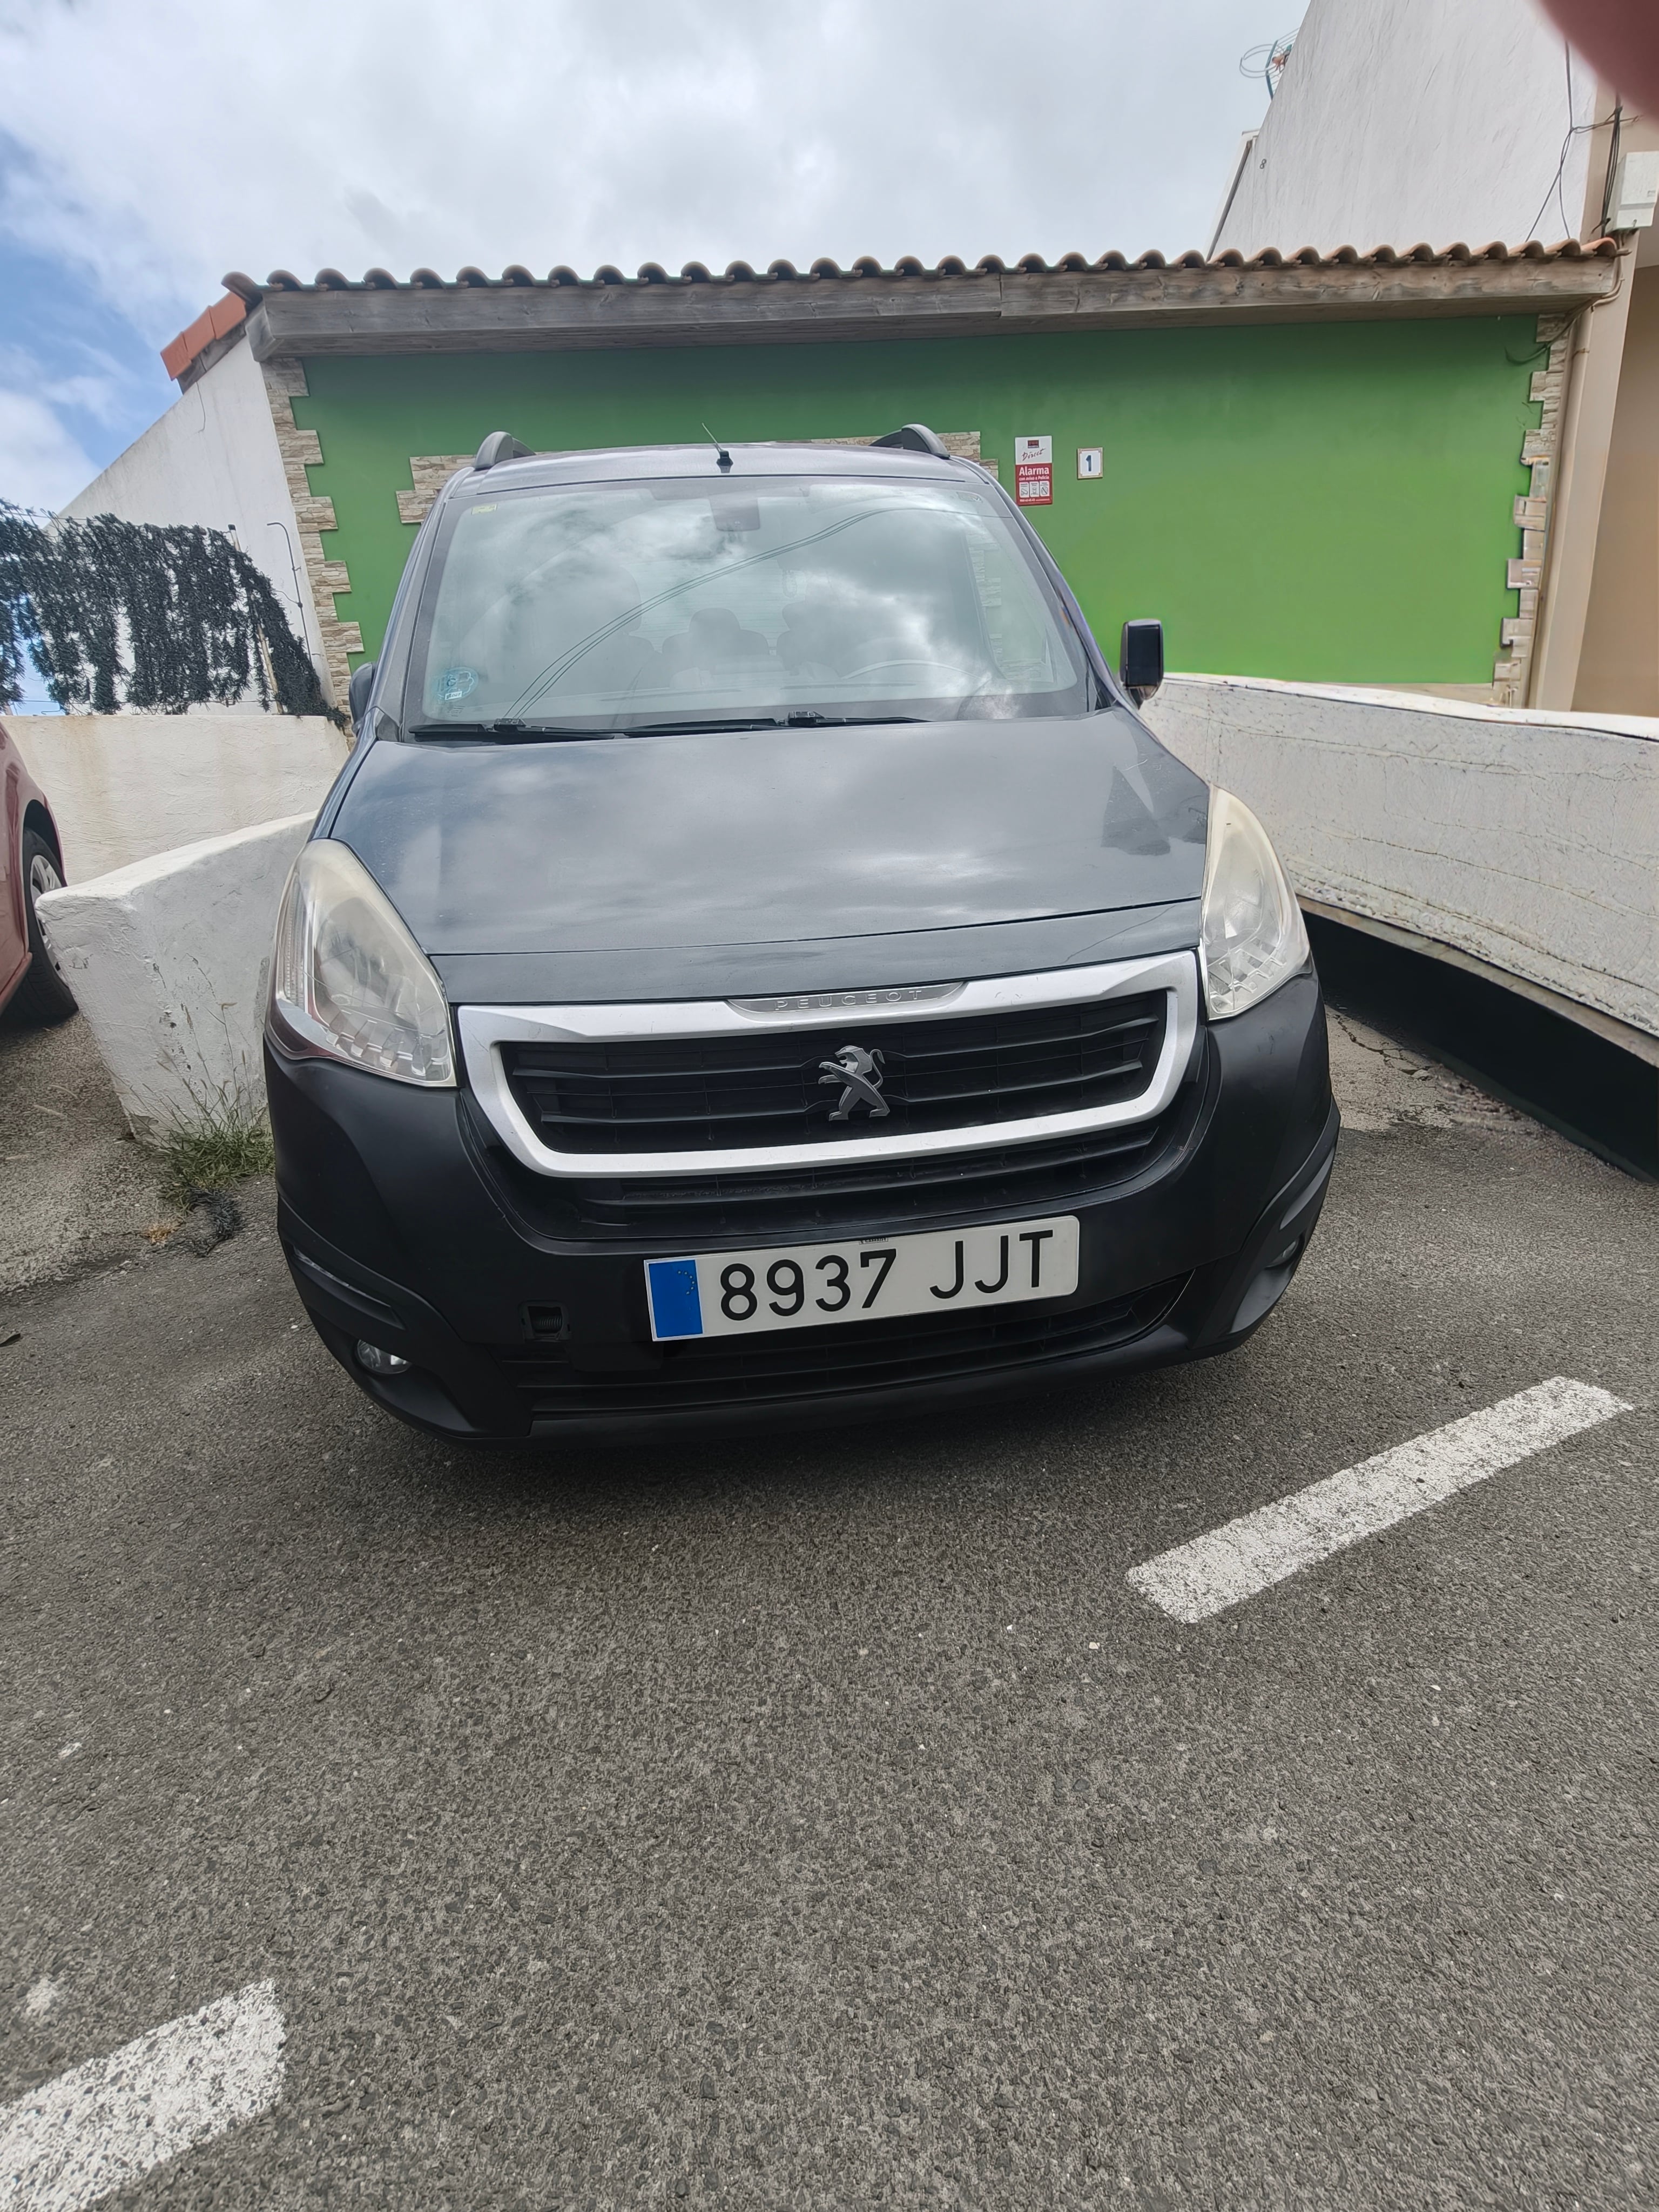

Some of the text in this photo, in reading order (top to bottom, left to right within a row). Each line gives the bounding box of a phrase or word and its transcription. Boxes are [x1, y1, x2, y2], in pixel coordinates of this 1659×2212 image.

[1019, 466, 1049, 476] Alarma
[1085, 455, 1091, 471] 1
[774, 990, 922, 1011] PEUGEOT
[720, 1230, 1054, 1321] 8937 JJT
